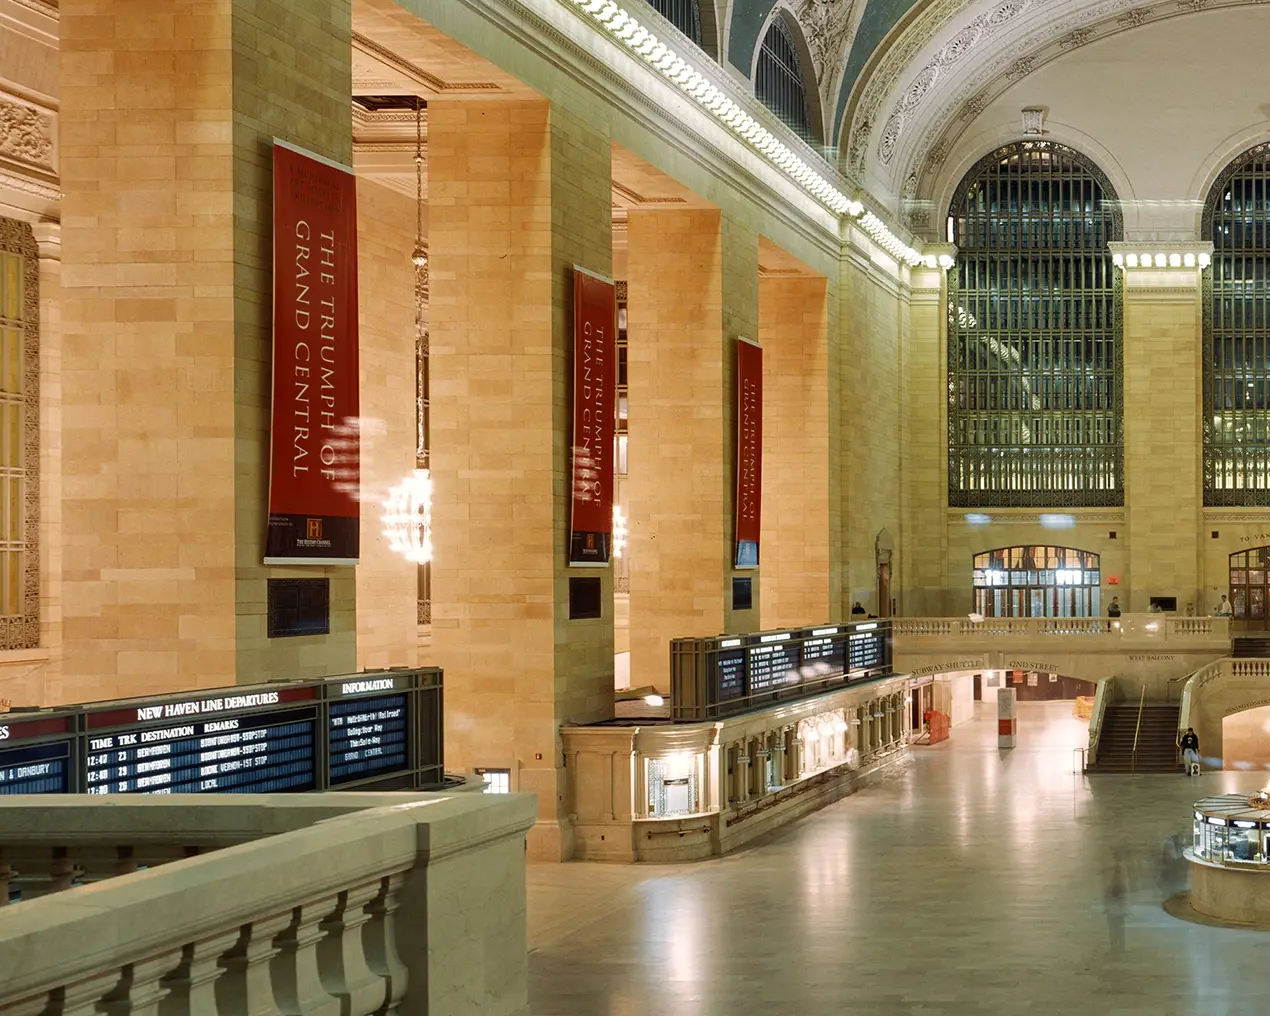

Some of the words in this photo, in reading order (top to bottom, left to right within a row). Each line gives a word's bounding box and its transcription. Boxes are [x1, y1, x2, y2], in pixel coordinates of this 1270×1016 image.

[319, 228, 335, 285] THE
[294, 219, 311, 330] GRAND
[583, 321, 593, 400] GRAND
[596, 325, 604, 366] THE
[319, 296, 336, 433] TRIUMPH
[293, 341, 310, 479] CENTRAL
[595, 375, 604, 470] TRIUMPH
[320, 444, 337, 482] OF
[594, 481, 602, 507] OF
[911, 663, 944, 676] SUBWAY
[945, 660, 981, 671] SHUTTLE
[1008, 660, 1029, 669] 42ND
[1031, 661, 1059, 672] STREET
[342, 678, 394, 694] INFORMATION
[137, 706, 163, 721] NEW
[165, 701, 200, 717] HAVEN
[201, 697, 223, 712] LINE
[224, 692, 279, 709] DEPARTURES
[90, 737, 113, 751] TIME
[118, 733, 138, 746] TRK
[141, 726, 194, 743] DESTINATION
[204, 719, 240, 733] REMARKS
[17, 764, 50, 778] DANBURY
[254, 756, 268, 766] STOP
